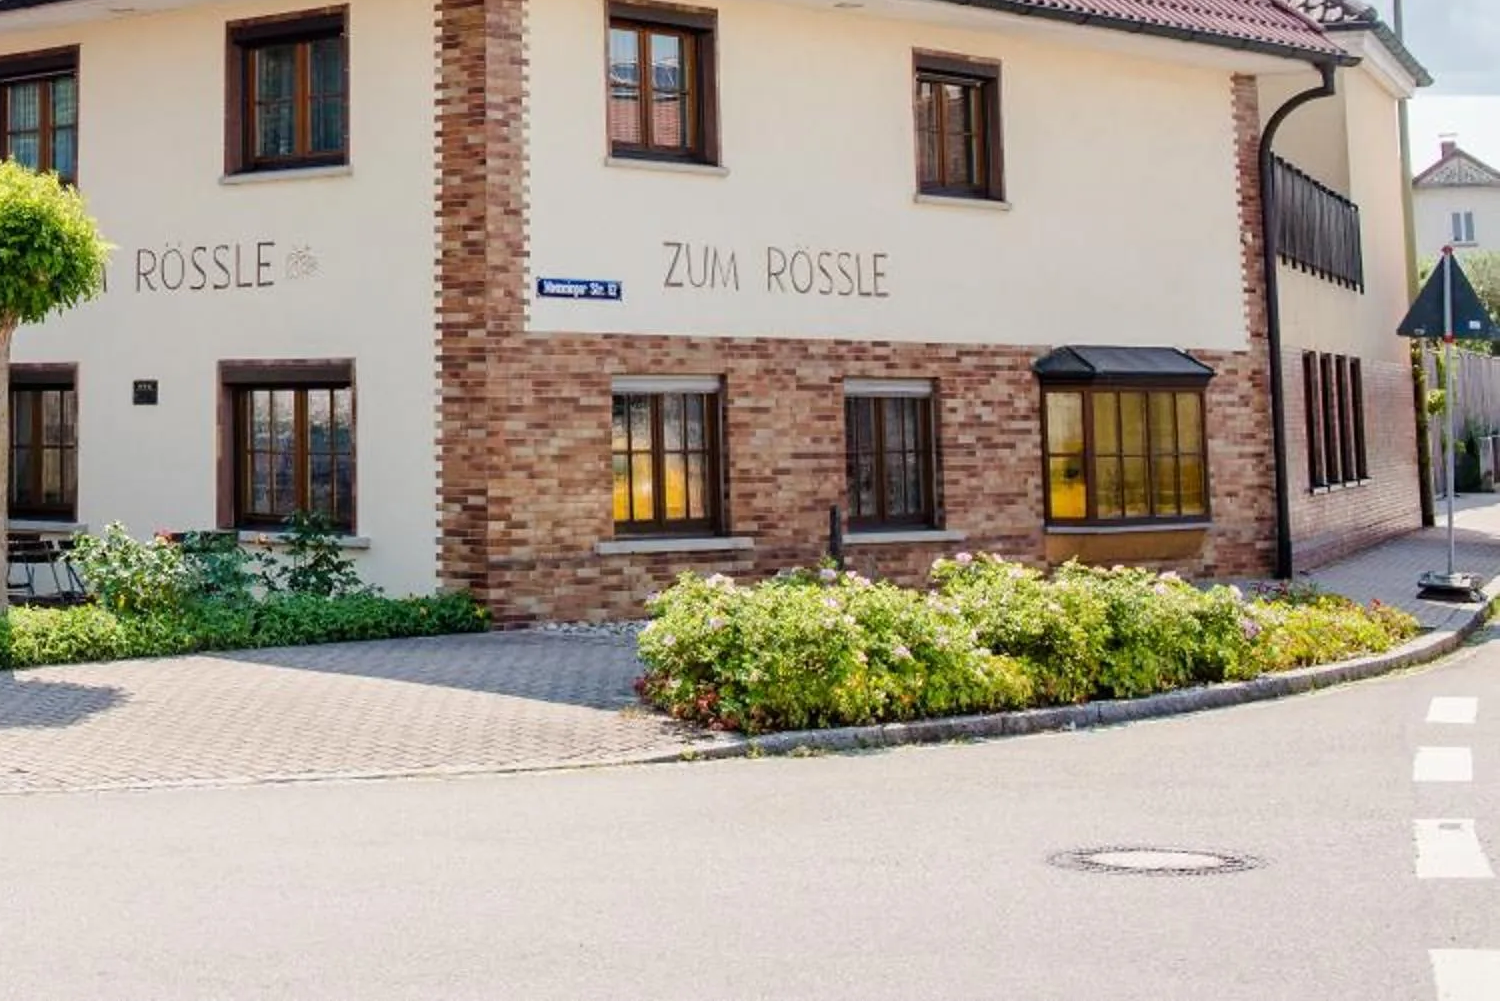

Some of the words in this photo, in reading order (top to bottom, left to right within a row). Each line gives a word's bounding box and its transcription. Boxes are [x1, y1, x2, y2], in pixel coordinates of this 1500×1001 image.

[136, 241, 275, 292] RÖSSLE
[663, 242, 739, 291] ZUM
[767, 246, 889, 297] RÖSSLE
